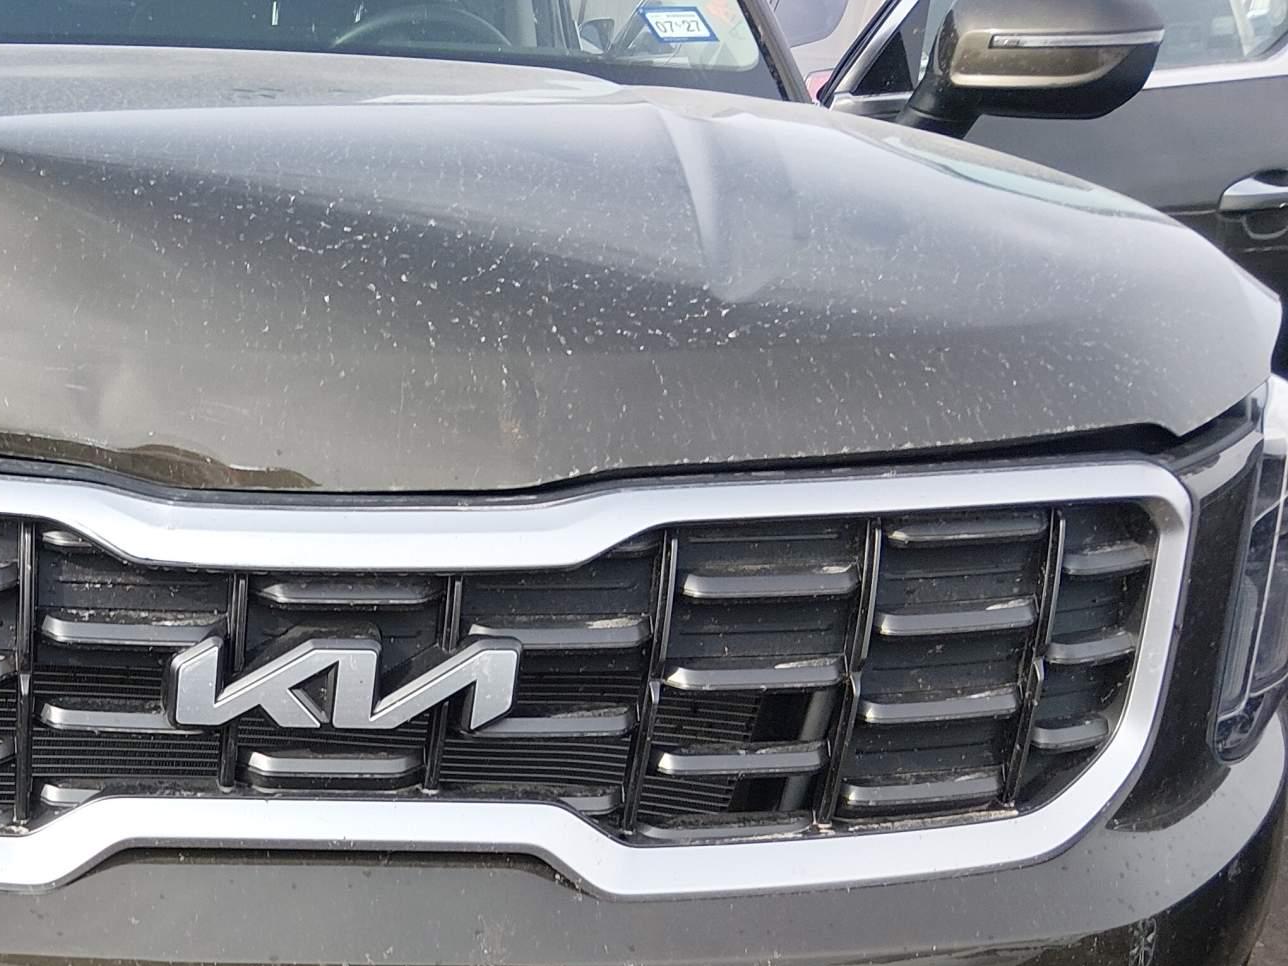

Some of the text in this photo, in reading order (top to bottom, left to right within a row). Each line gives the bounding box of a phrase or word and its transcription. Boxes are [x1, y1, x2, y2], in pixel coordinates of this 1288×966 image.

[655, 19, 701, 33] 07 27
[171, 637, 521, 732] KIA
